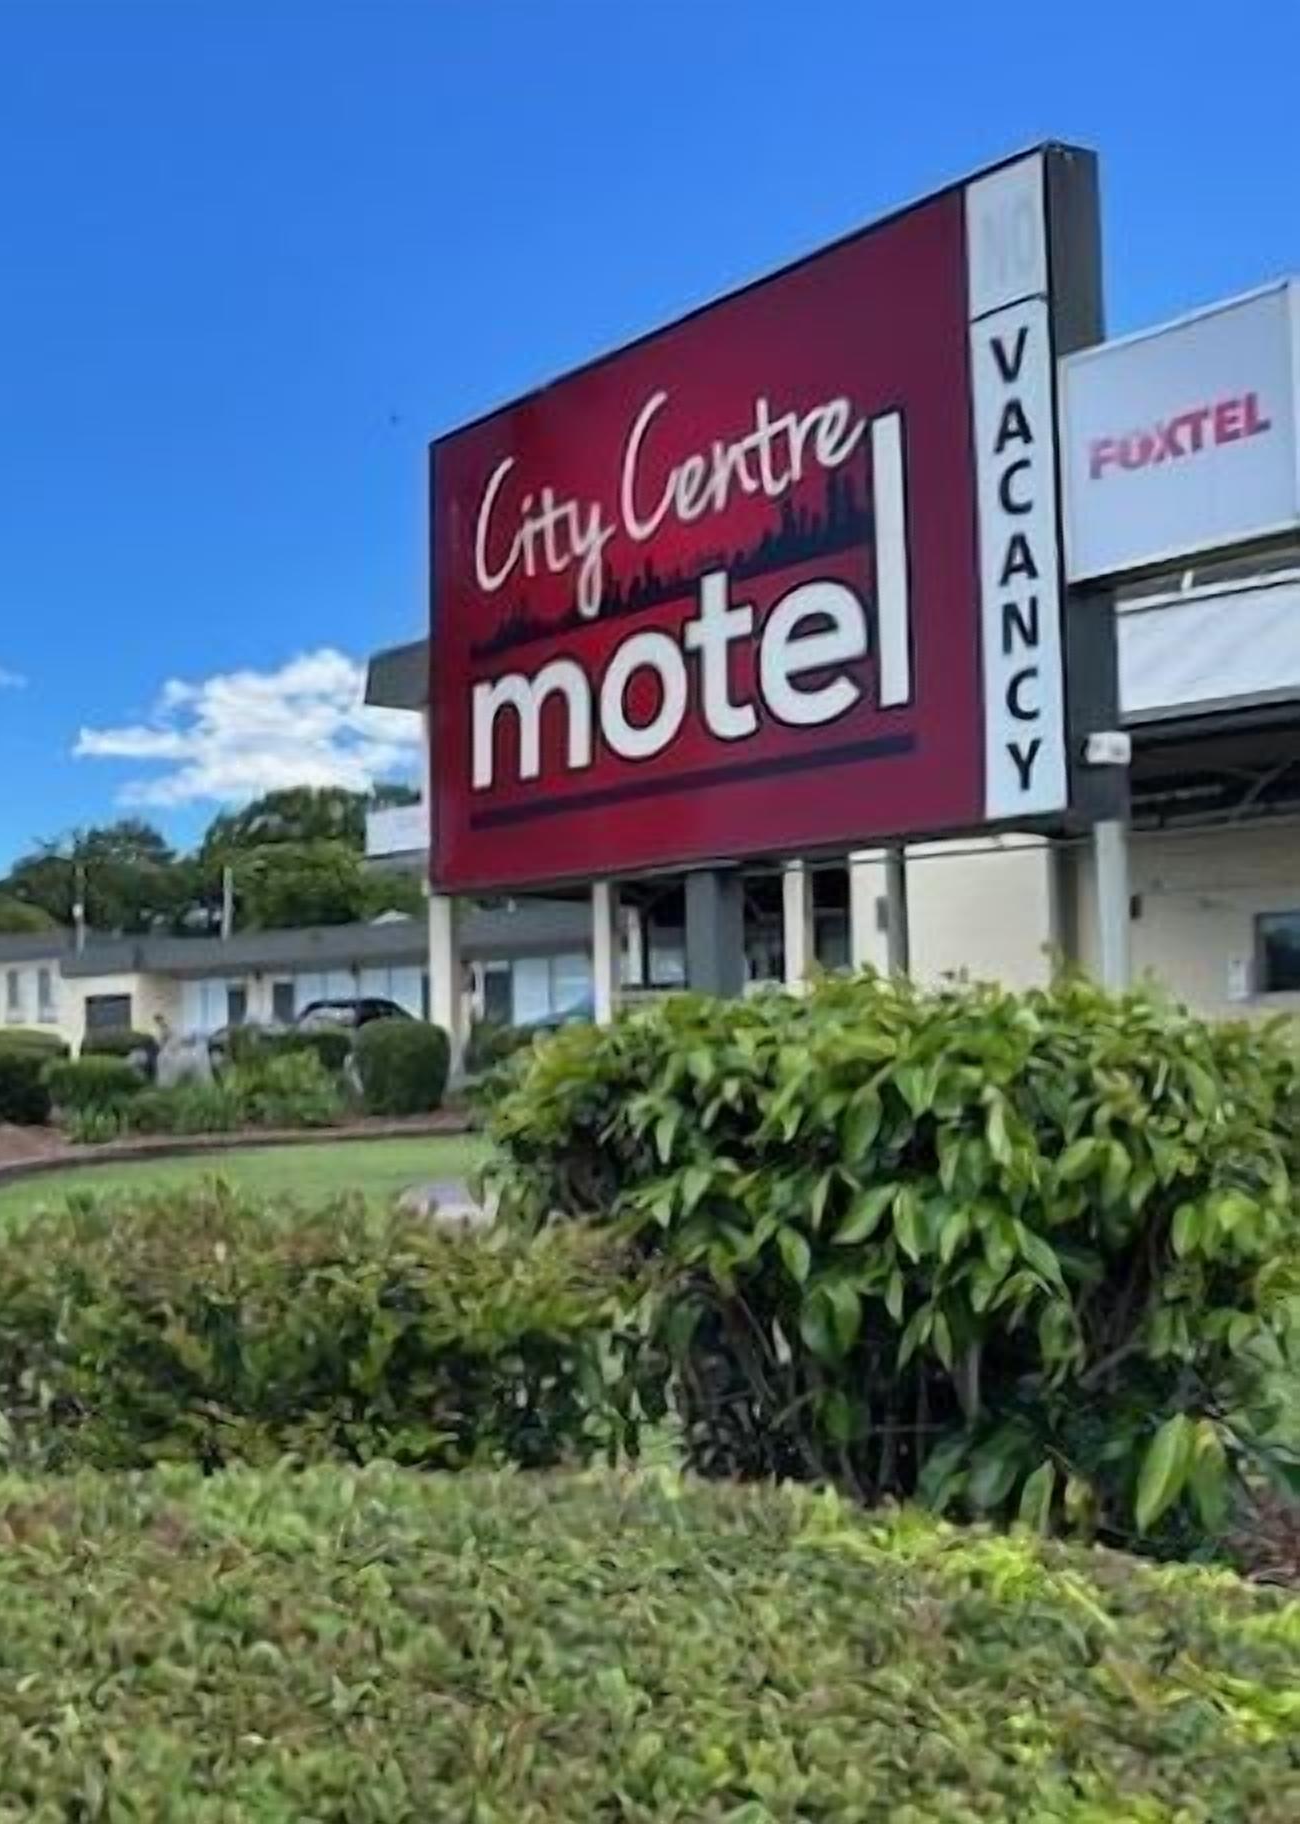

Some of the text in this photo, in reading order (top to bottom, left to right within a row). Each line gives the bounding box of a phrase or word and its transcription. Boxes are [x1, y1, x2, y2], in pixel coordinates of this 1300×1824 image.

[475, 390, 868, 619] City Centre
[989, 326, 1042, 792] VACANCY
[1089, 391, 1272, 480] FOXTEL
[471, 411, 910, 790] motel
